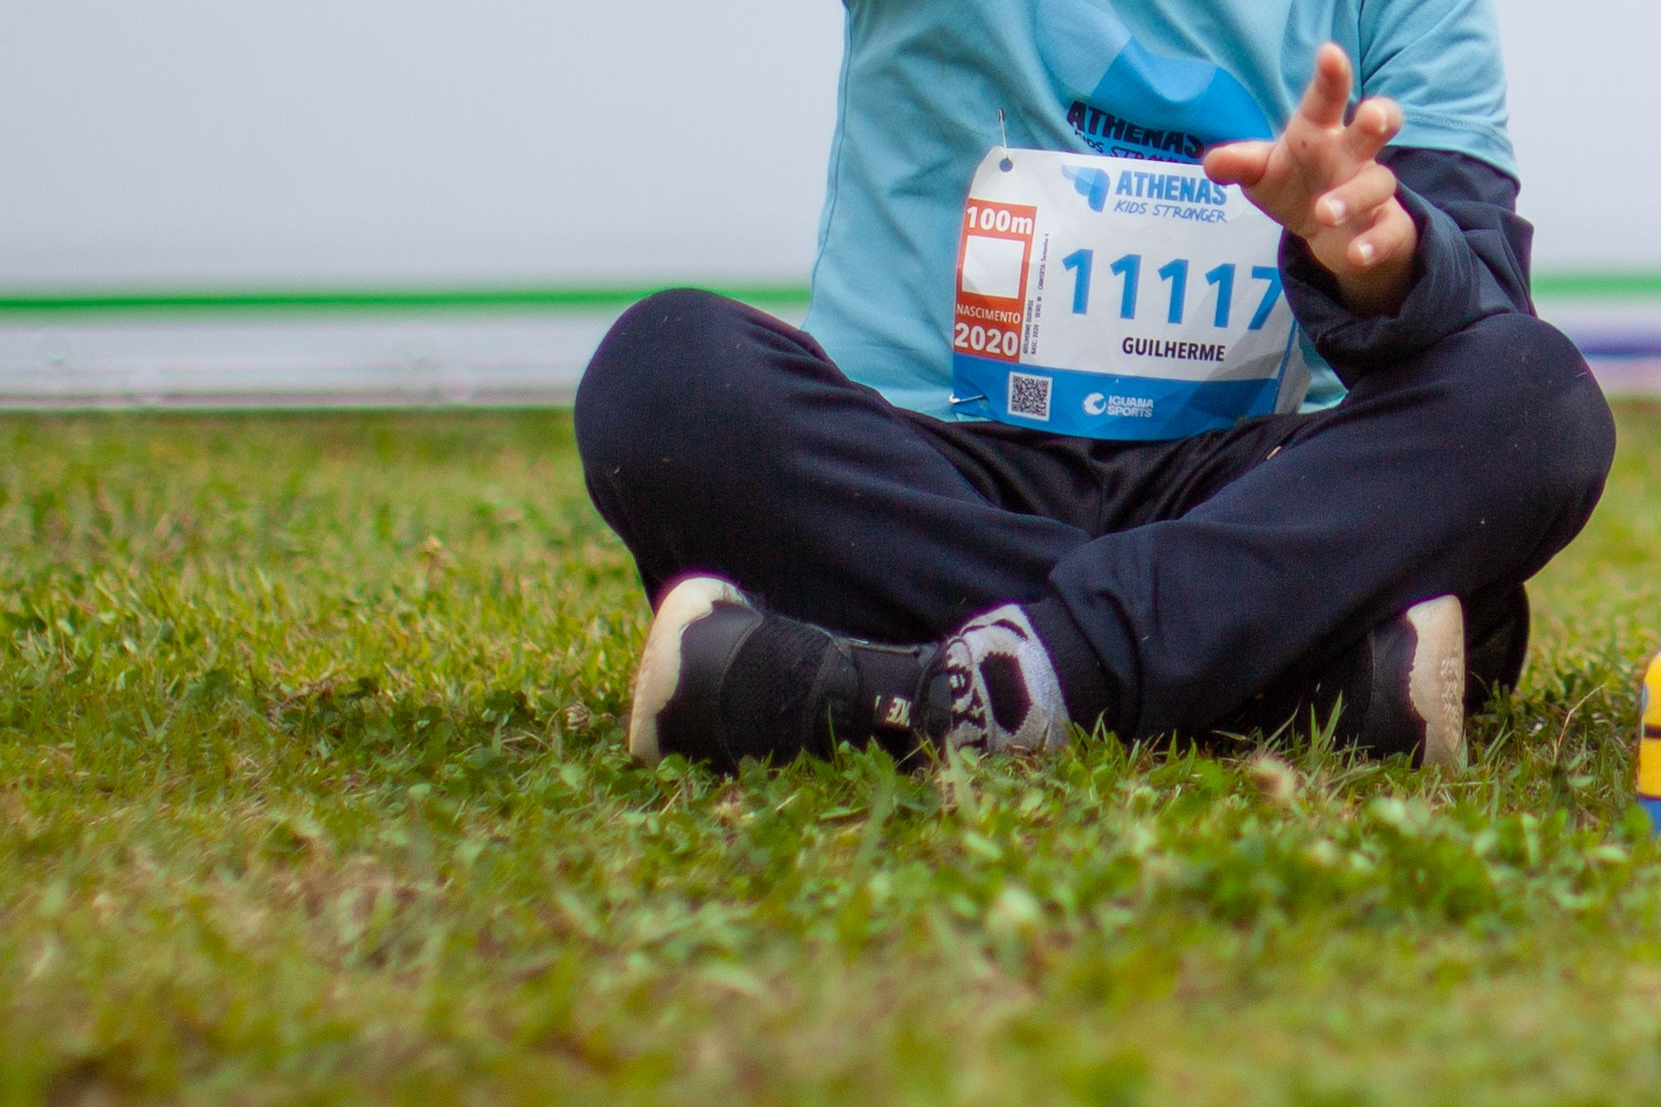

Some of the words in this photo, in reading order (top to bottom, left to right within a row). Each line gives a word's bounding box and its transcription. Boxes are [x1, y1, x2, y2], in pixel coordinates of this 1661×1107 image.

[1067, 100, 1205, 159] ATHENAS
[1115, 170, 1228, 206] ATHENAS
[967, 206, 1033, 235] 100m
[1114, 199, 1147, 215] KIDS
[1152, 204, 1228, 224] STRONGER
[1062, 248, 1284, 331] 11117
[956, 303, 1021, 325] NASCIMENTO
[954, 322, 1019, 357] 2020
[1122, 337, 1226, 362] GUILHERME
[1107, 405, 1153, 418] SPORTS
[1108, 395, 1153, 409] IGUANA
